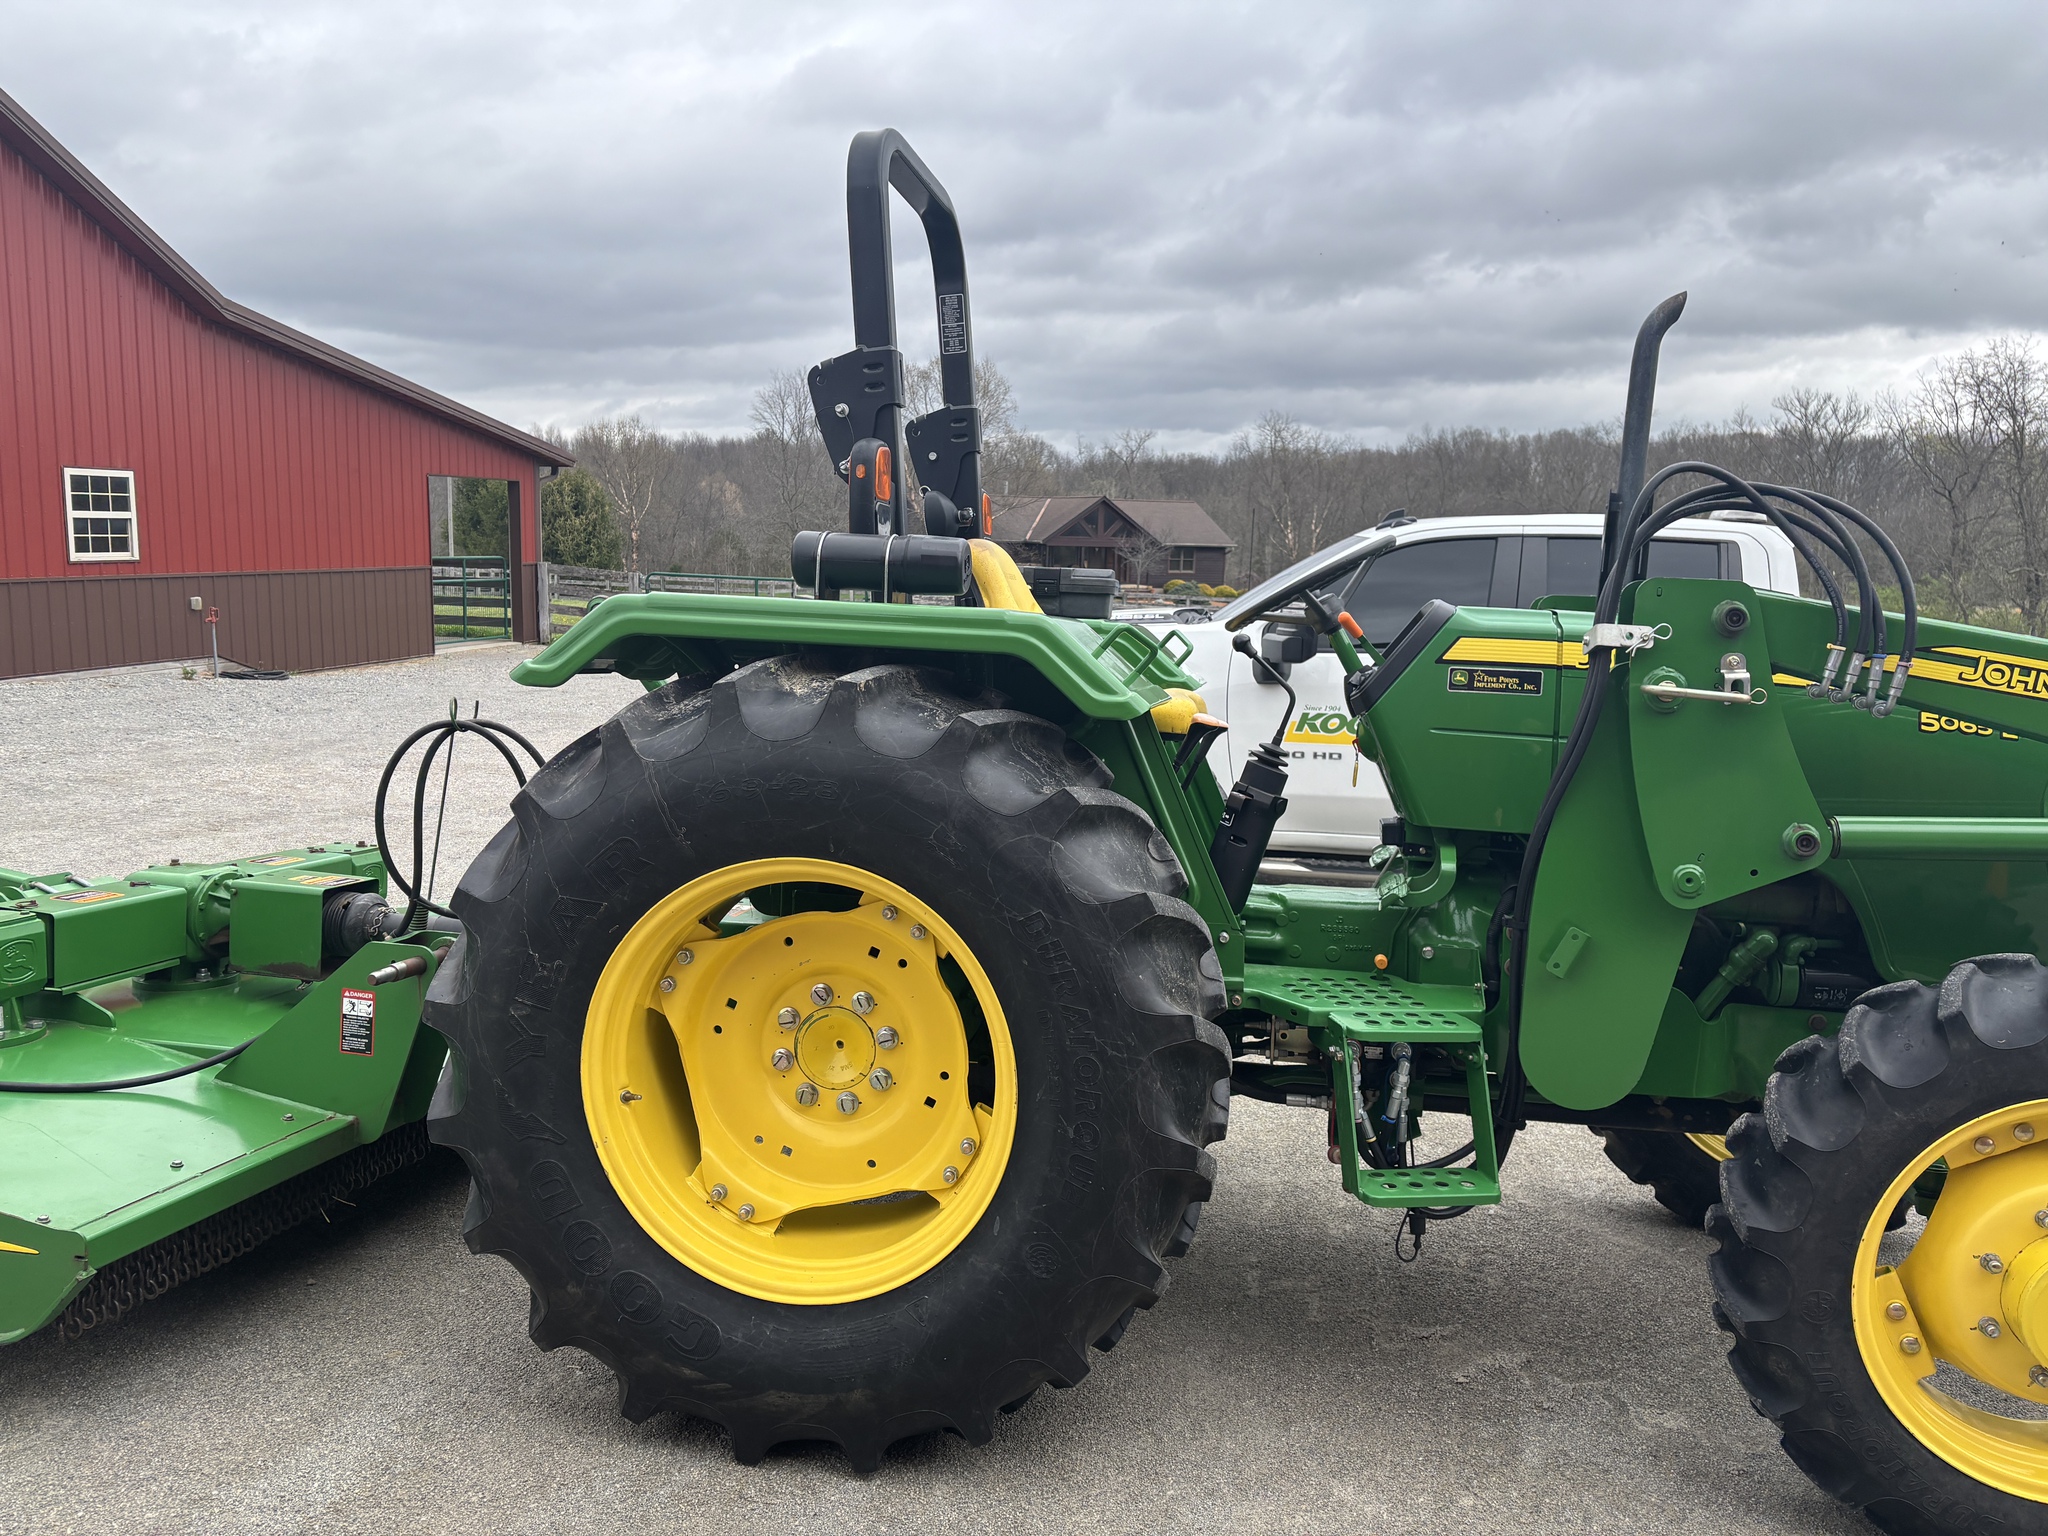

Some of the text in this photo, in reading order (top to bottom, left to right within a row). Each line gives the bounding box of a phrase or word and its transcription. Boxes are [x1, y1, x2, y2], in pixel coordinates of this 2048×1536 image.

[1303, 704, 1323, 712] Since
[1313, 752, 1342, 760] HD
[350, 991, 373, 999] DANGER
